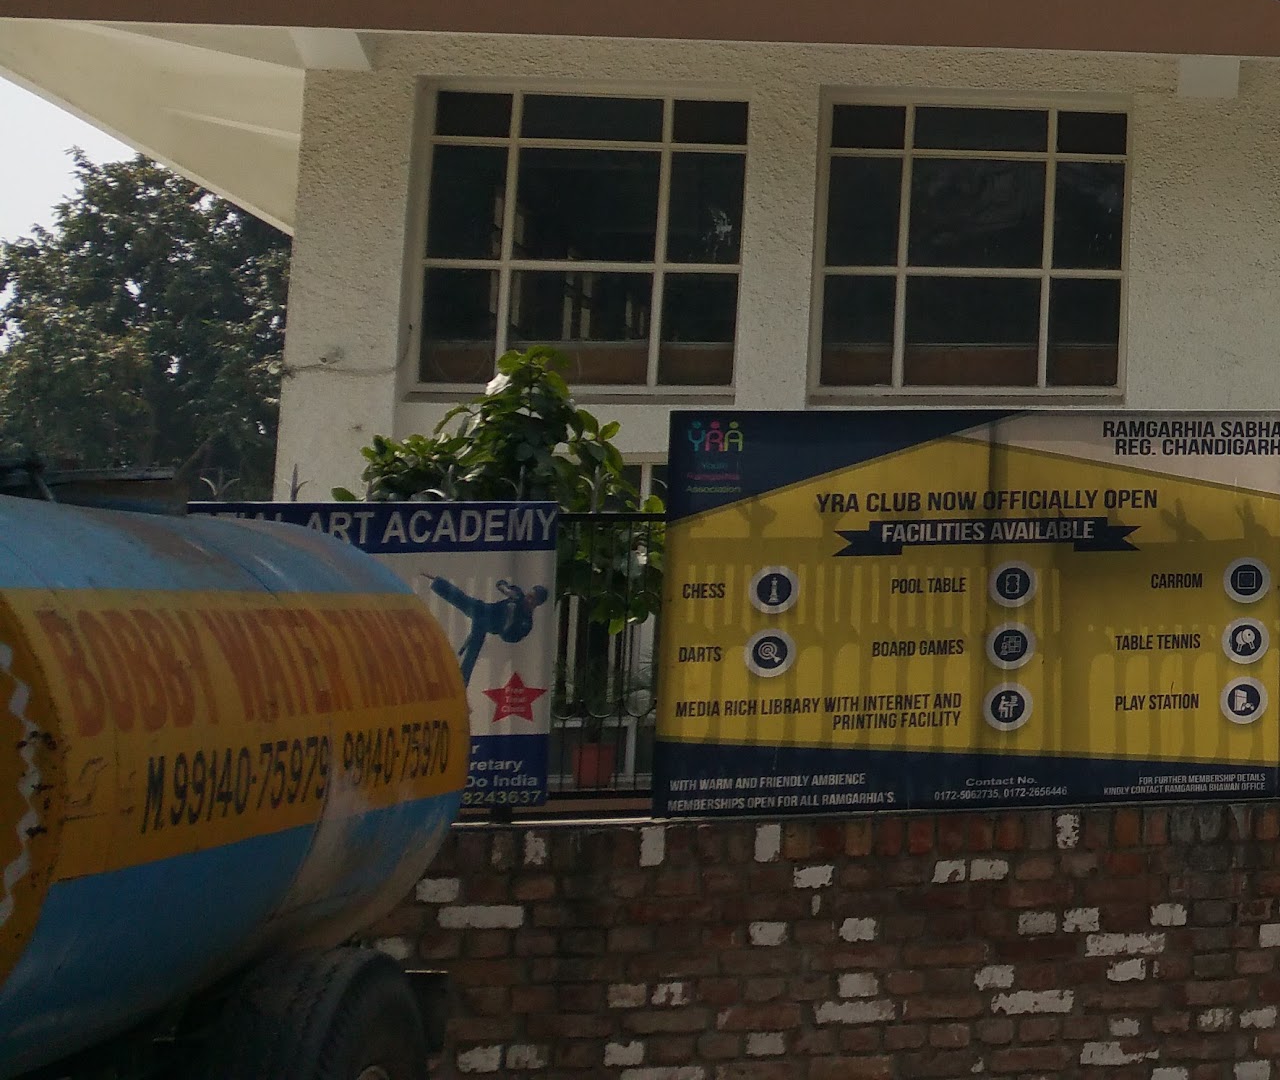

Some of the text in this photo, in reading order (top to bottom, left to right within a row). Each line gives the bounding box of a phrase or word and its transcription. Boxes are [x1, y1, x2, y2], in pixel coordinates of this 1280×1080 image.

[688, 421, 743, 451] YRA
[1103, 421, 1215, 437] RAMGARHIA
[1115, 439, 1156, 455] REG.
[817, 489, 1157, 512] YRA CLUB NOW OFFICIALLY OPEN
[307, 509, 557, 545] ART ACADEMY
[882, 520, 1095, 542] FACILITIES AVAILABLE
[891, 577, 966, 594] POOL TABLE
[1151, 573, 1202, 589] CARROM
[682, 583, 725, 599] CHESS
[872, 640, 964, 657] BOARD GAMES
[1115, 634, 1200, 650] TABLE TENNIS
[679, 646, 722, 662] DARTS
[676, 693, 962, 717] MEDIA RICH LIBRARY WITH INTERNET AND
[1115, 694, 1199, 711] PLAY STATION
[833, 711, 960, 730] PRINTING FACILITY
[469, 759, 522, 772] retary
[493, 774, 538, 787] India
[669, 773, 866, 791] WITH WARM AND FRIENDLY AMBIENCE
[966, 776, 1038, 786] Contact No.
[1139, 773, 1265, 785] FOR FURTHER MEMBERSHIP DETAILS
[1103, 782, 1265, 795] KINDLY CONTACT RAMGARHIA BHAWAN OFFICE
[462, 790, 541, 805] 8243637
[667, 798, 745, 811] MEMBERSHIPS
[747, 797, 775, 808] OPEN
[777, 796, 798, 807] FOR
[800, 794, 819, 806] ALL
